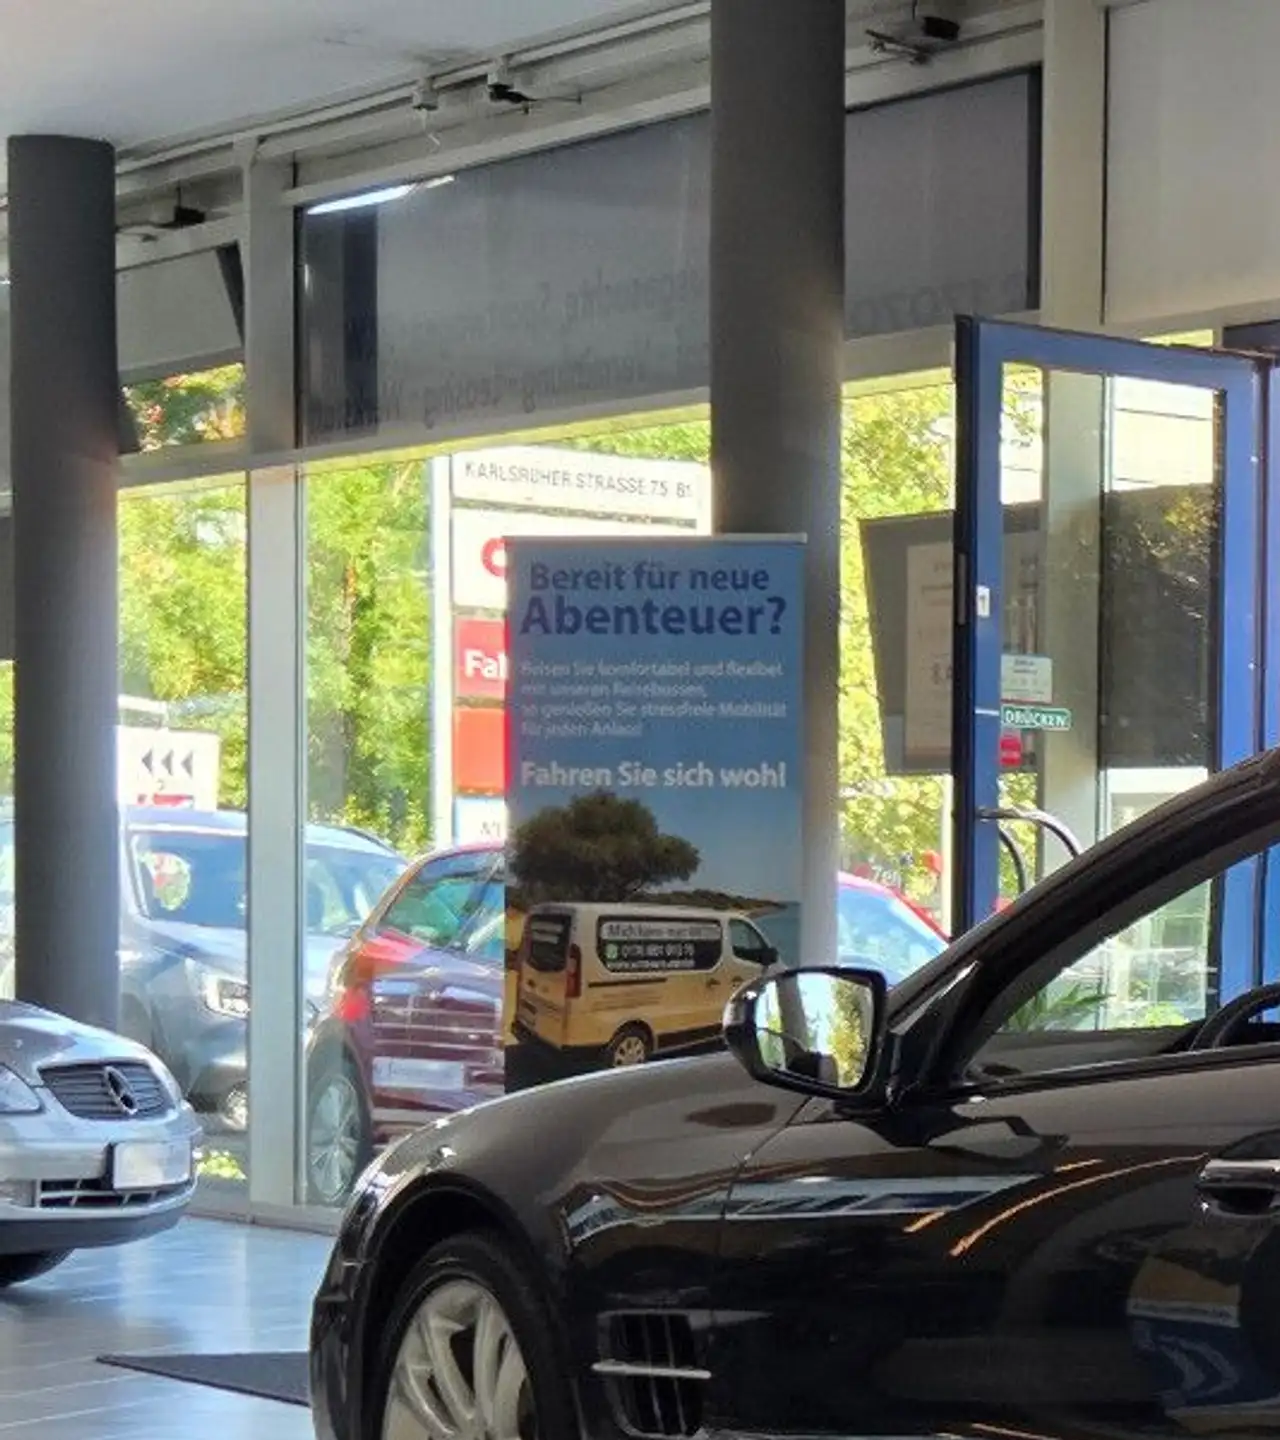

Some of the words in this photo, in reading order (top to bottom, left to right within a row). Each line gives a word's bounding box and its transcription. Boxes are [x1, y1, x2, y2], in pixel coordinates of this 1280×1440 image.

[576, 472, 645, 496] STRASSE
[531, 561, 627, 591] Bereit
[632, 560, 680, 591] für
[689, 567, 770, 591] neue
[519, 596, 787, 636] Abenteuer?
[521, 761, 612, 788] Fahren
[618, 761, 657, 788] Sie
[663, 761, 715, 788] sich
[720, 761, 786, 788] wohl
